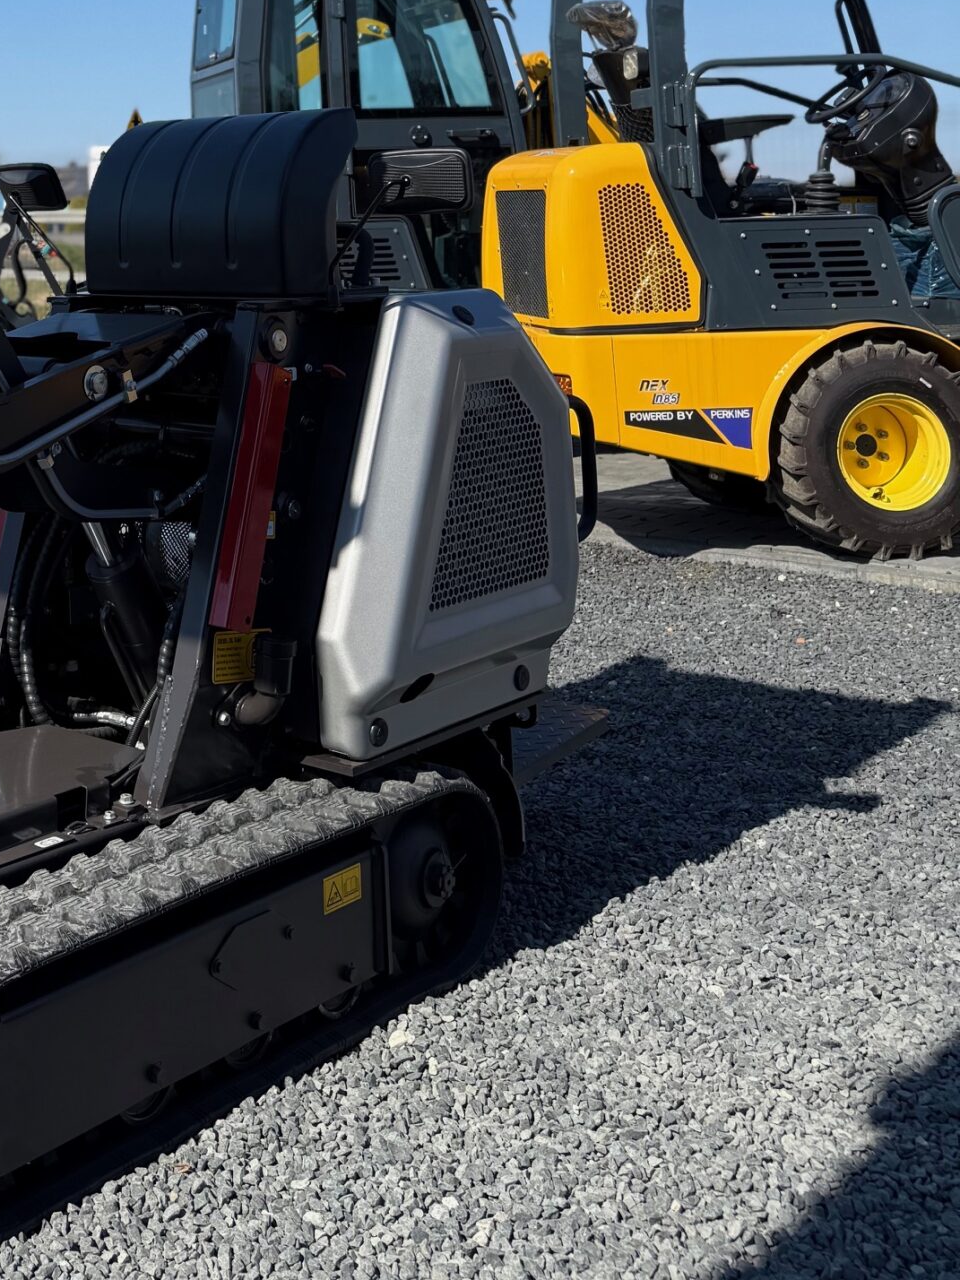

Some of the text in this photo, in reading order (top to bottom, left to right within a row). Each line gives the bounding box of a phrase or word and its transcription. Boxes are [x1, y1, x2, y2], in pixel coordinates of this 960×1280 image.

[629, 409, 750, 421] POWERED BY PERKINS
